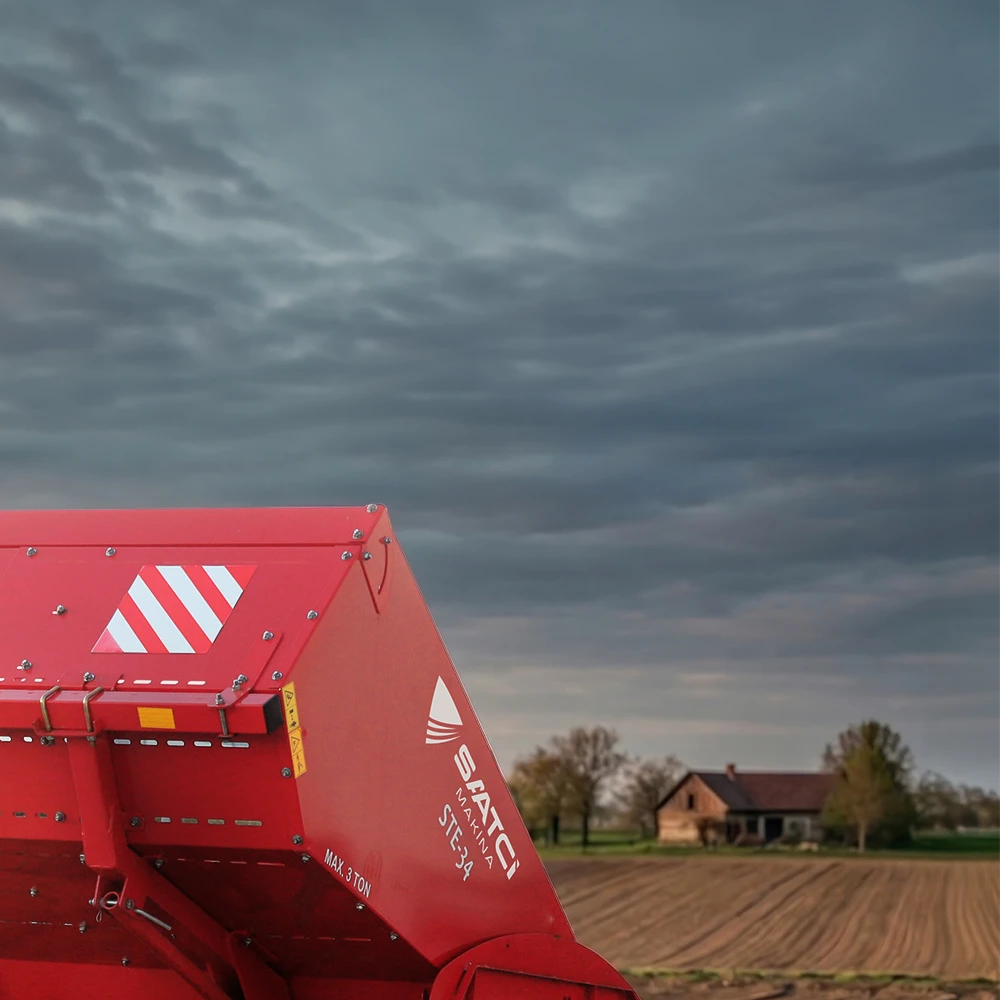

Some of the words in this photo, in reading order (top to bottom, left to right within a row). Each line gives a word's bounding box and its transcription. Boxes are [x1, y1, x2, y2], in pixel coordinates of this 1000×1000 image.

[324, 848, 345, 877] MAX.
[345, 867, 352, 882] 3
[353, 871, 372, 898] TON
[438, 804, 474, 881] STE-34
